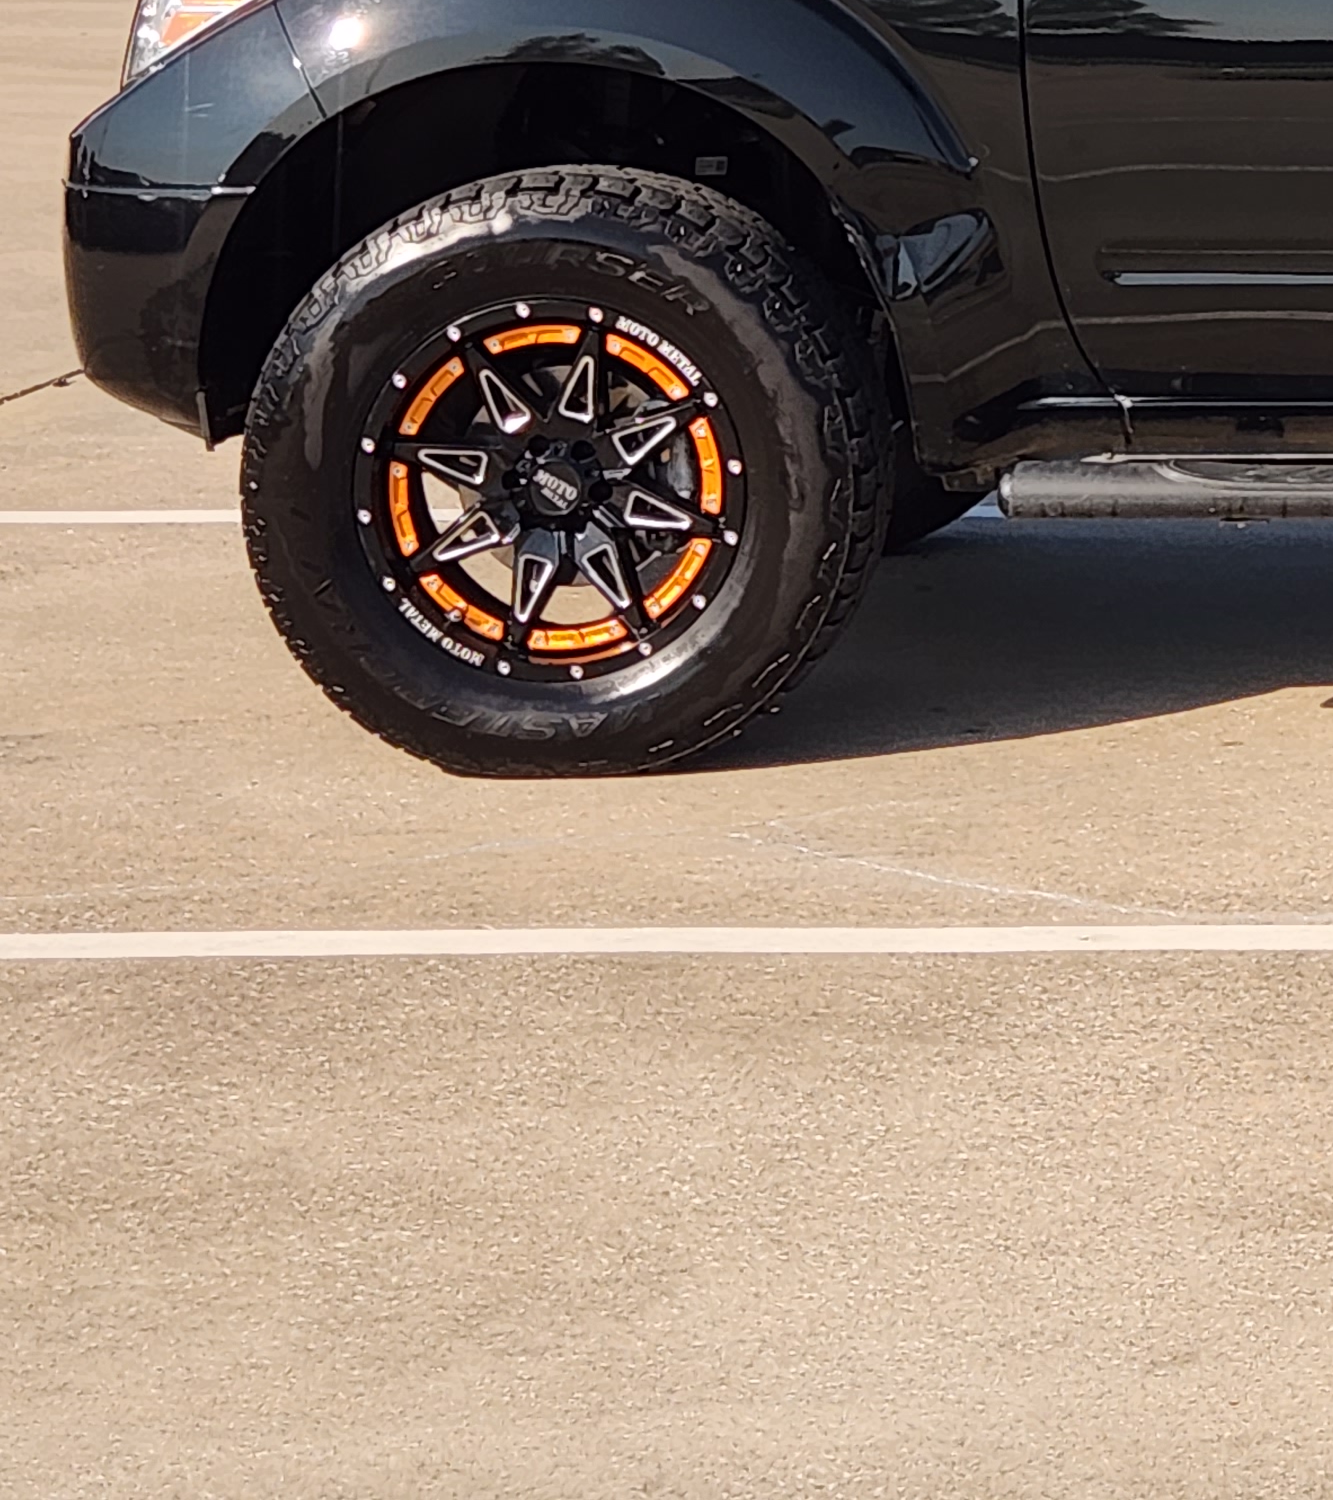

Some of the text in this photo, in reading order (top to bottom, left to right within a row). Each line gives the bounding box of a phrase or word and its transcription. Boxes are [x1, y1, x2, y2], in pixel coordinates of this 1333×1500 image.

[615, 315, 702, 387] MOTO METAL
[532, 469, 578, 501] MOTO
[398, 597, 485, 667] MOTO METAL
